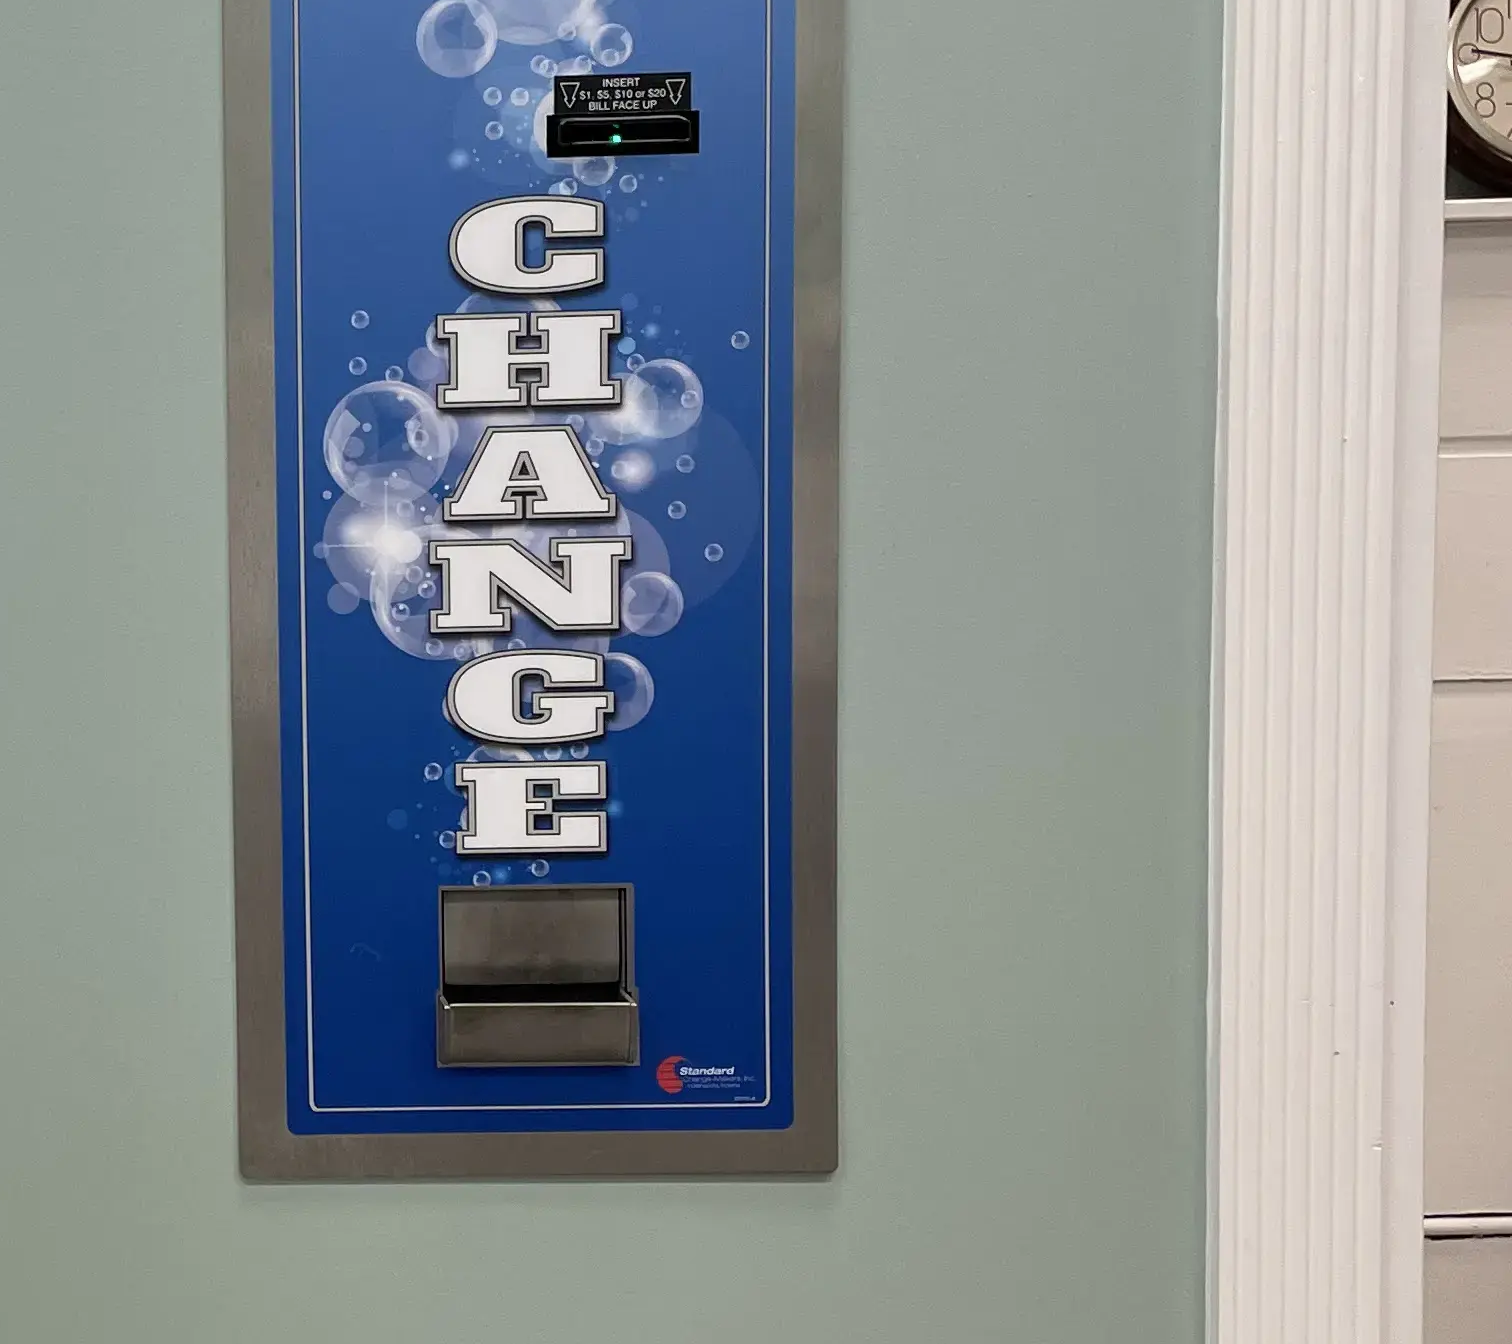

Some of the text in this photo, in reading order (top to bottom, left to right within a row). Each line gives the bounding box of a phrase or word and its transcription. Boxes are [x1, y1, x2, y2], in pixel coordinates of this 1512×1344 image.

[1473, 6, 1504, 44] 10
[602, 77, 641, 88] INSERT
[614, 89, 633, 99] $10
[635, 90, 645, 98] or
[647, 88, 667, 98] $20
[588, 100, 658, 111] BILL FACE UP
[1474, 81, 1497, 119] 8
[428, 193, 633, 856] CHANGE
[679, 1066, 736, 1076] Standard
